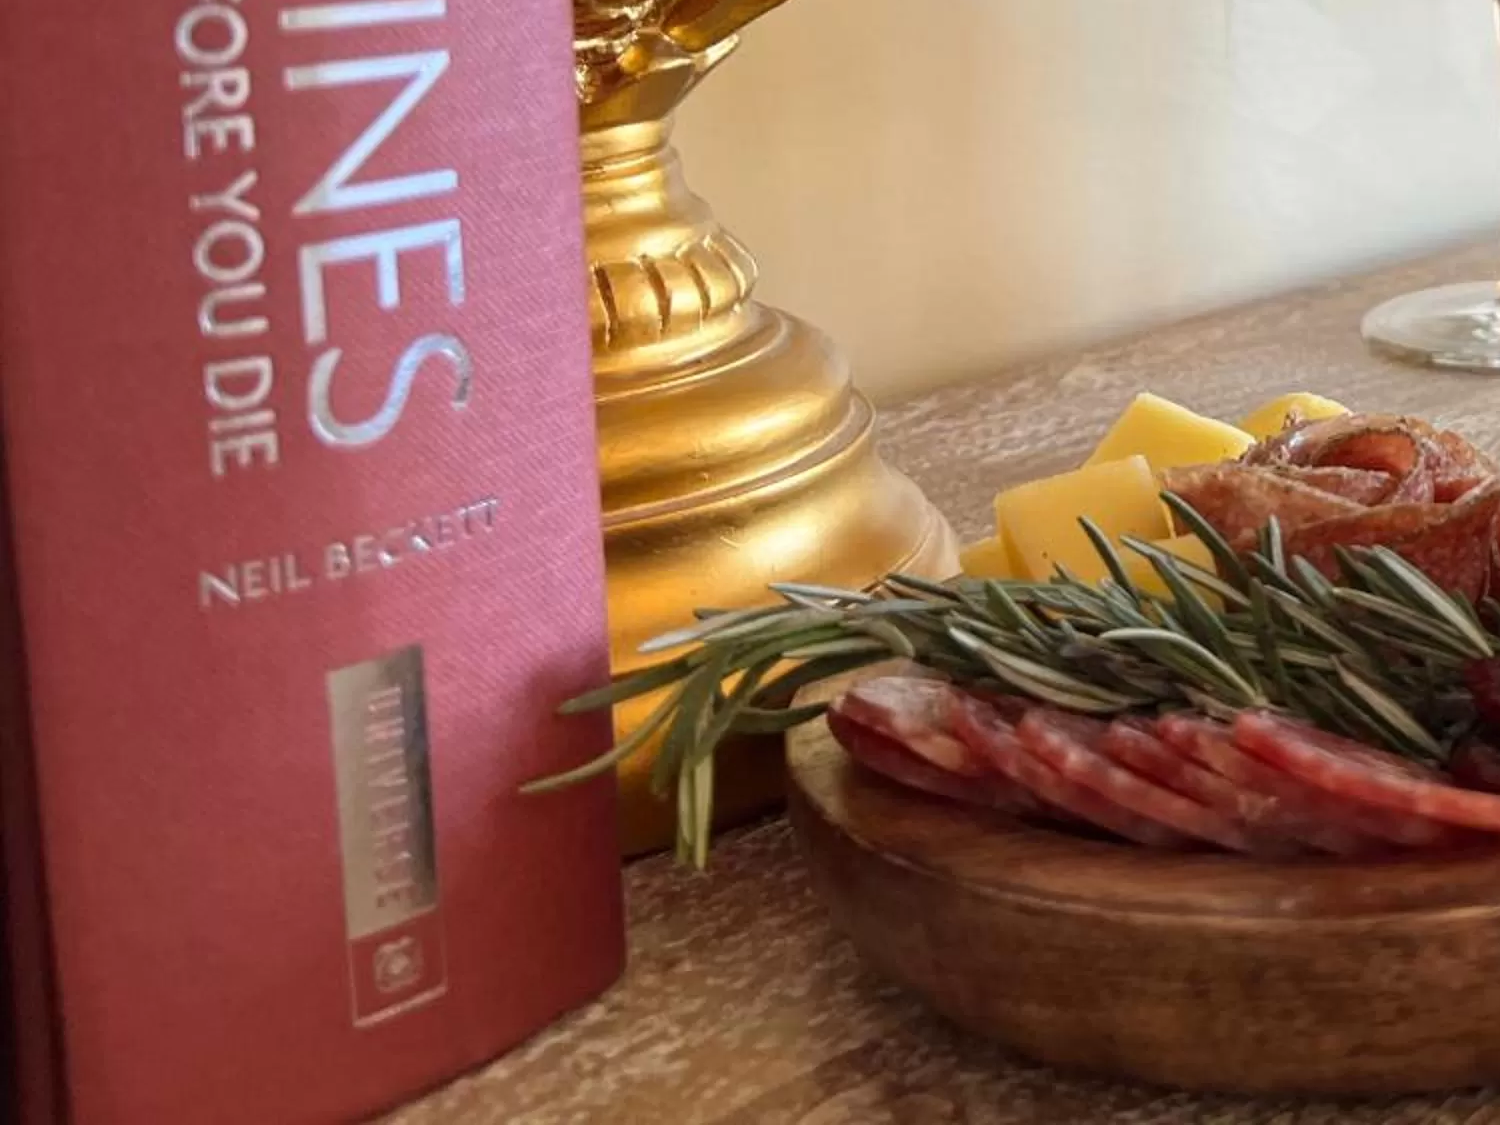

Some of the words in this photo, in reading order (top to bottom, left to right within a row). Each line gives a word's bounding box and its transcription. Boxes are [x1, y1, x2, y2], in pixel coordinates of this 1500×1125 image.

[189, 170, 270, 340] YOU
[203, 355, 280, 481] DIE
[199, 554, 311, 609] NEIL
[324, 495, 500, 581] BECKETT
